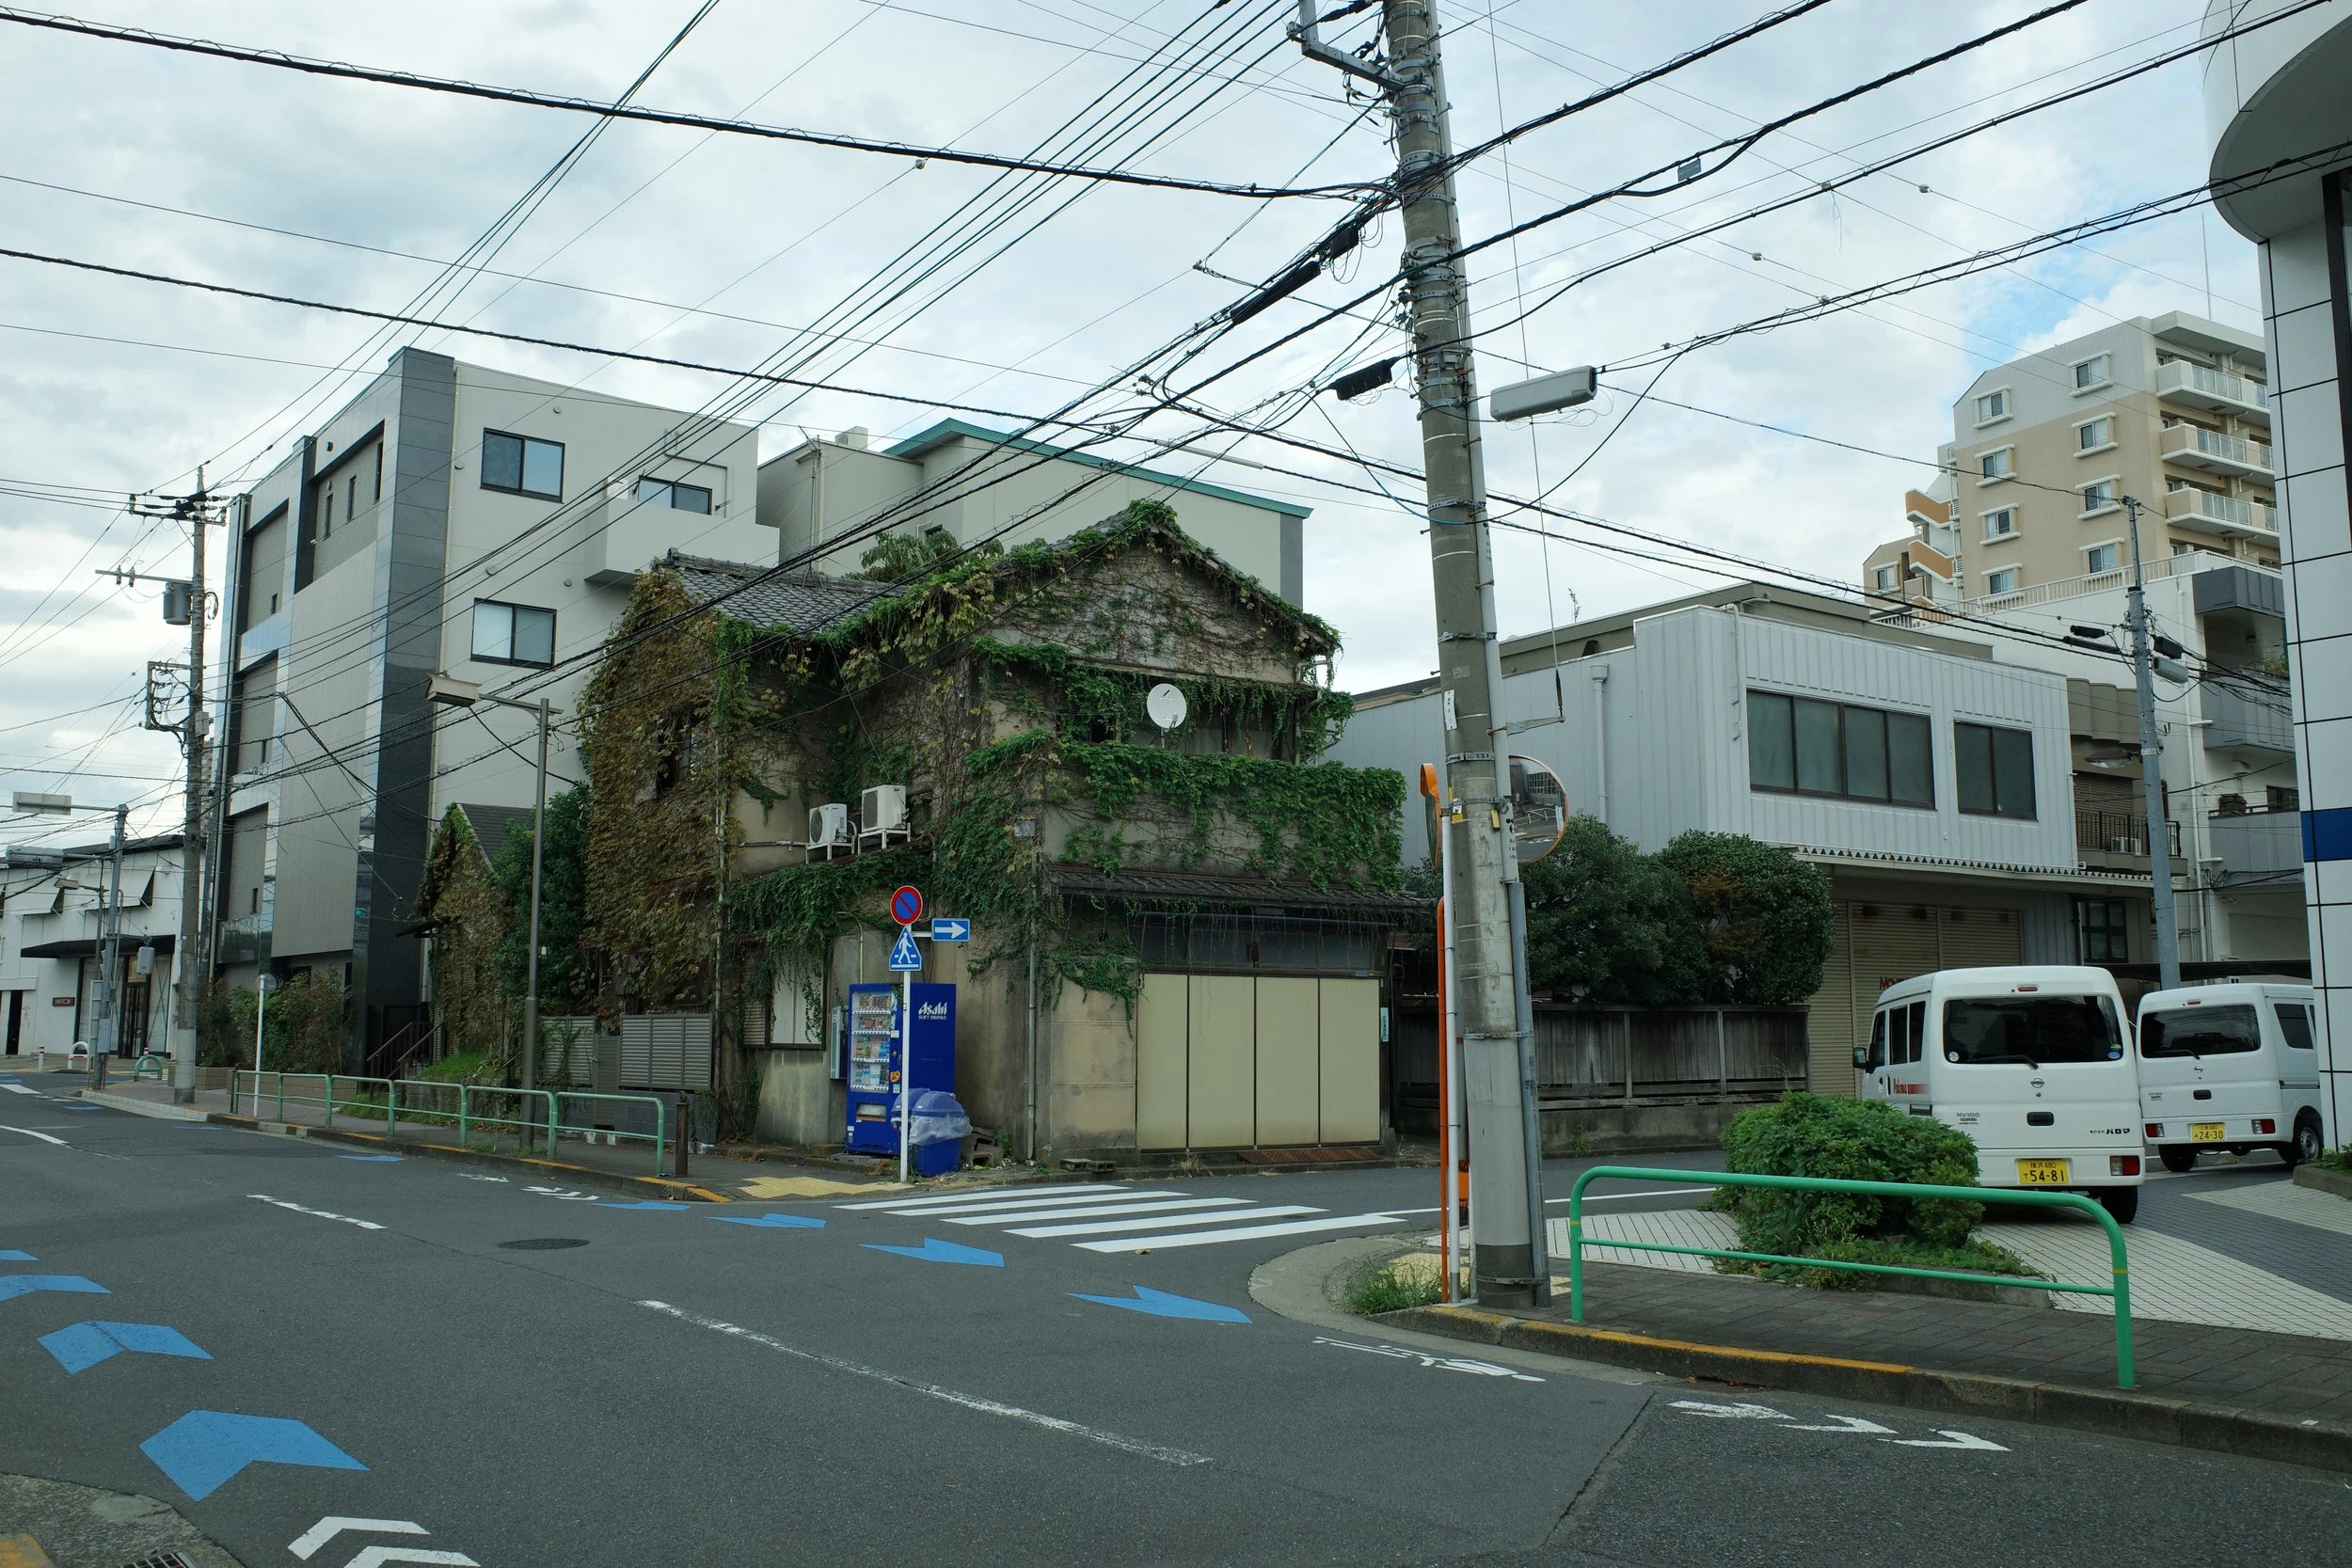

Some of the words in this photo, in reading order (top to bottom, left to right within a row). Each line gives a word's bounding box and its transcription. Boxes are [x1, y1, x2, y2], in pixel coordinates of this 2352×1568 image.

[918, 1002, 947, 1016] Asahi
[2199, 1131, 2223, 1140] 24-30
[2029, 1169, 2065, 1182] 54-81
